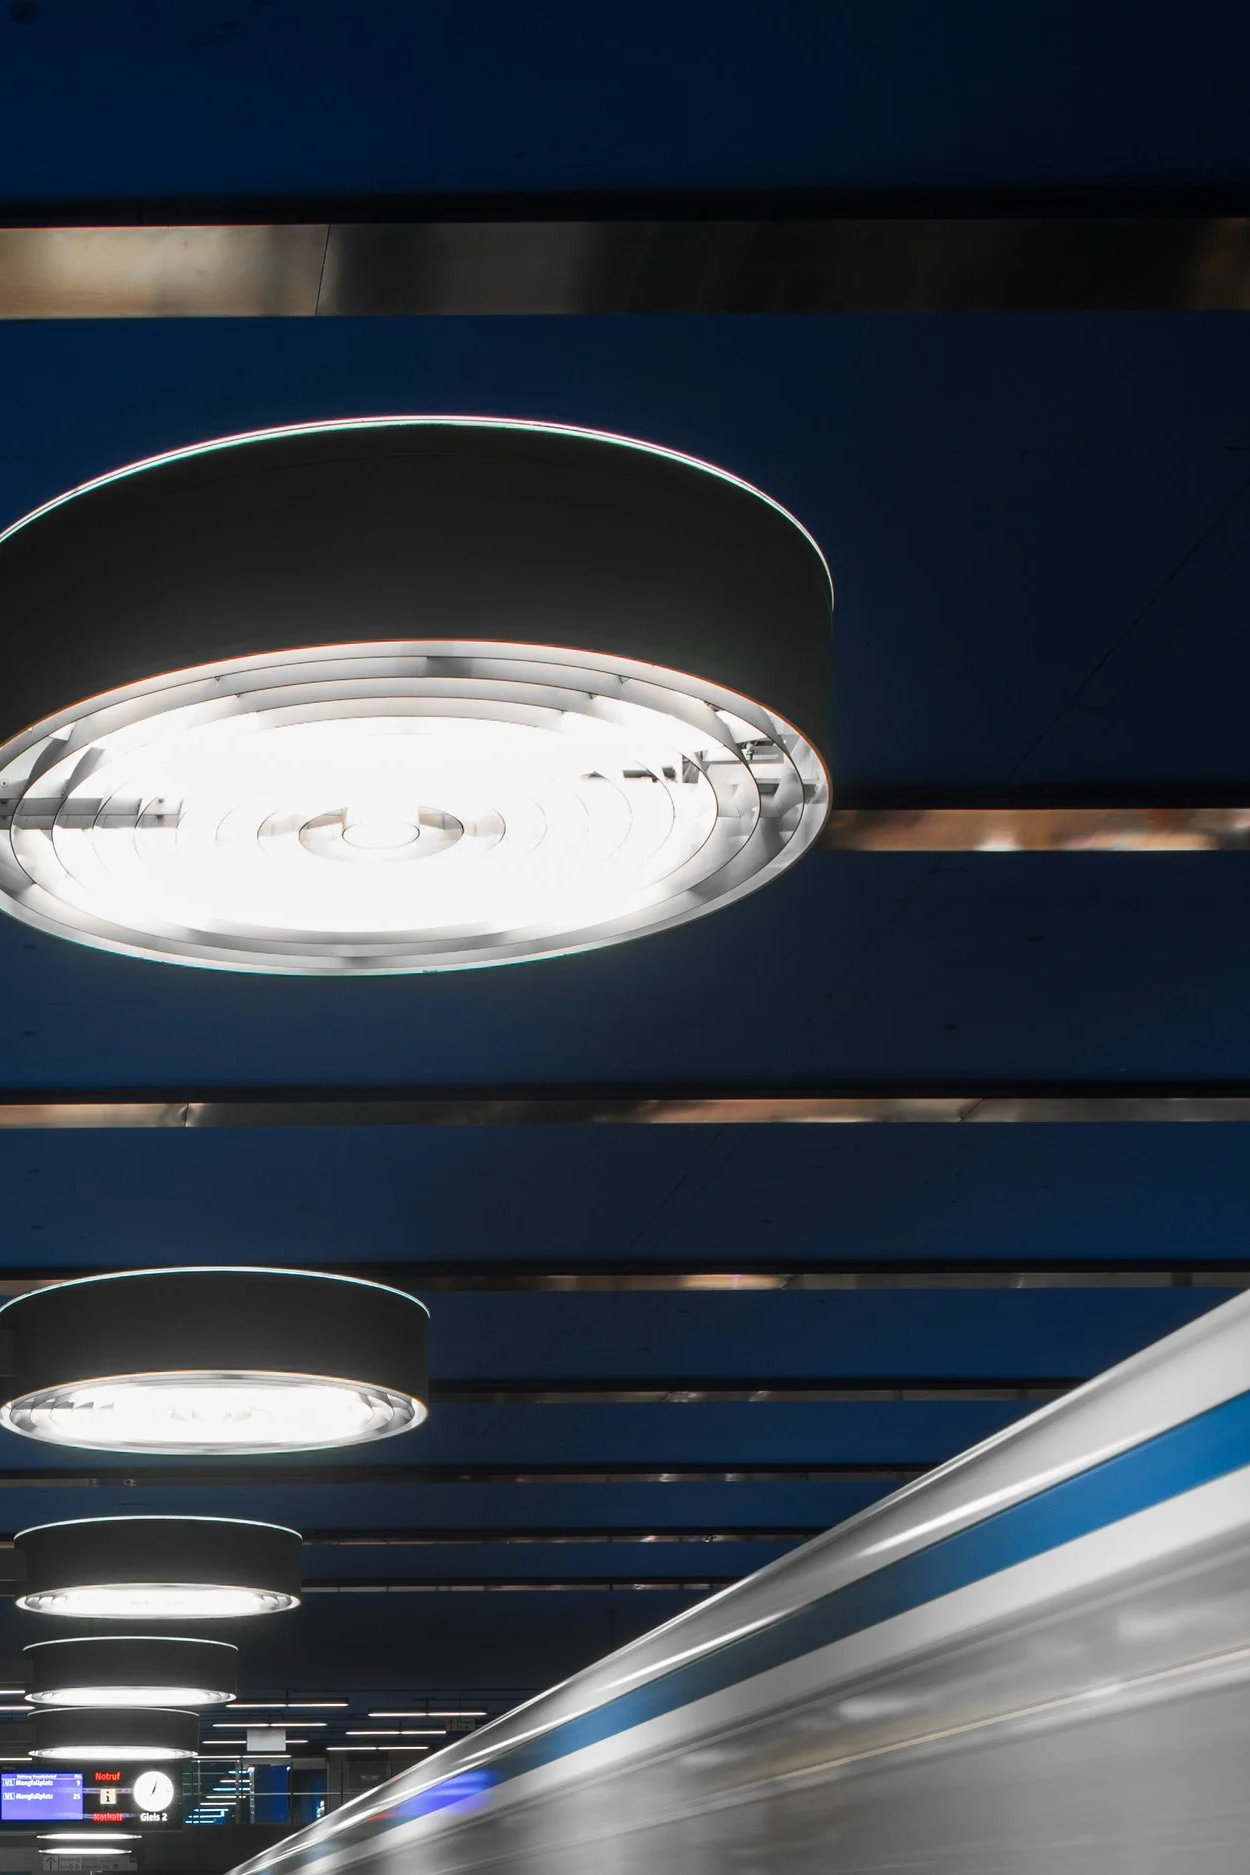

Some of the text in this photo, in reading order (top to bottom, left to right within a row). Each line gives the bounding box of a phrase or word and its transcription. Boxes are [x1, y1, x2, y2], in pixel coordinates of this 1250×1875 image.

[95, 1772, 120, 1780] Notruf
[93, 1811, 123, 1821] Nothalt
[140, 1812, 168, 1821] Gleis 2
